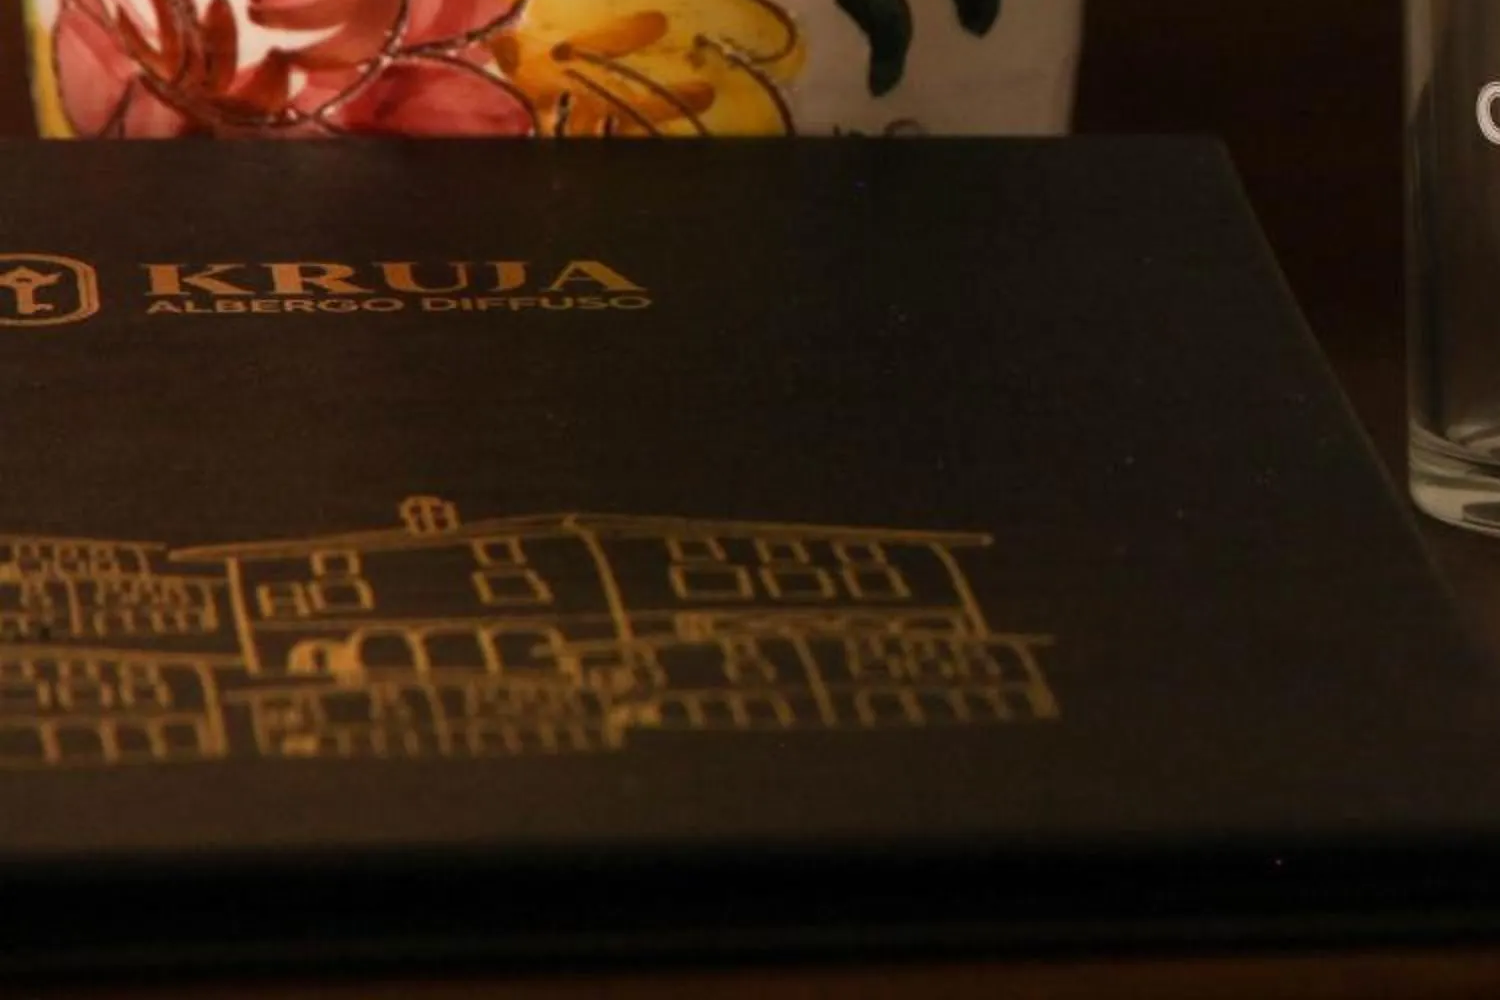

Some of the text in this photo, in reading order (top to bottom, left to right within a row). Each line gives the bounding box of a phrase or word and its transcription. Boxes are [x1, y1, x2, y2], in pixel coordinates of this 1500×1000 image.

[139, 260, 647, 296] KRUJA
[145, 296, 653, 314] ALBERGO DIFFUSO
